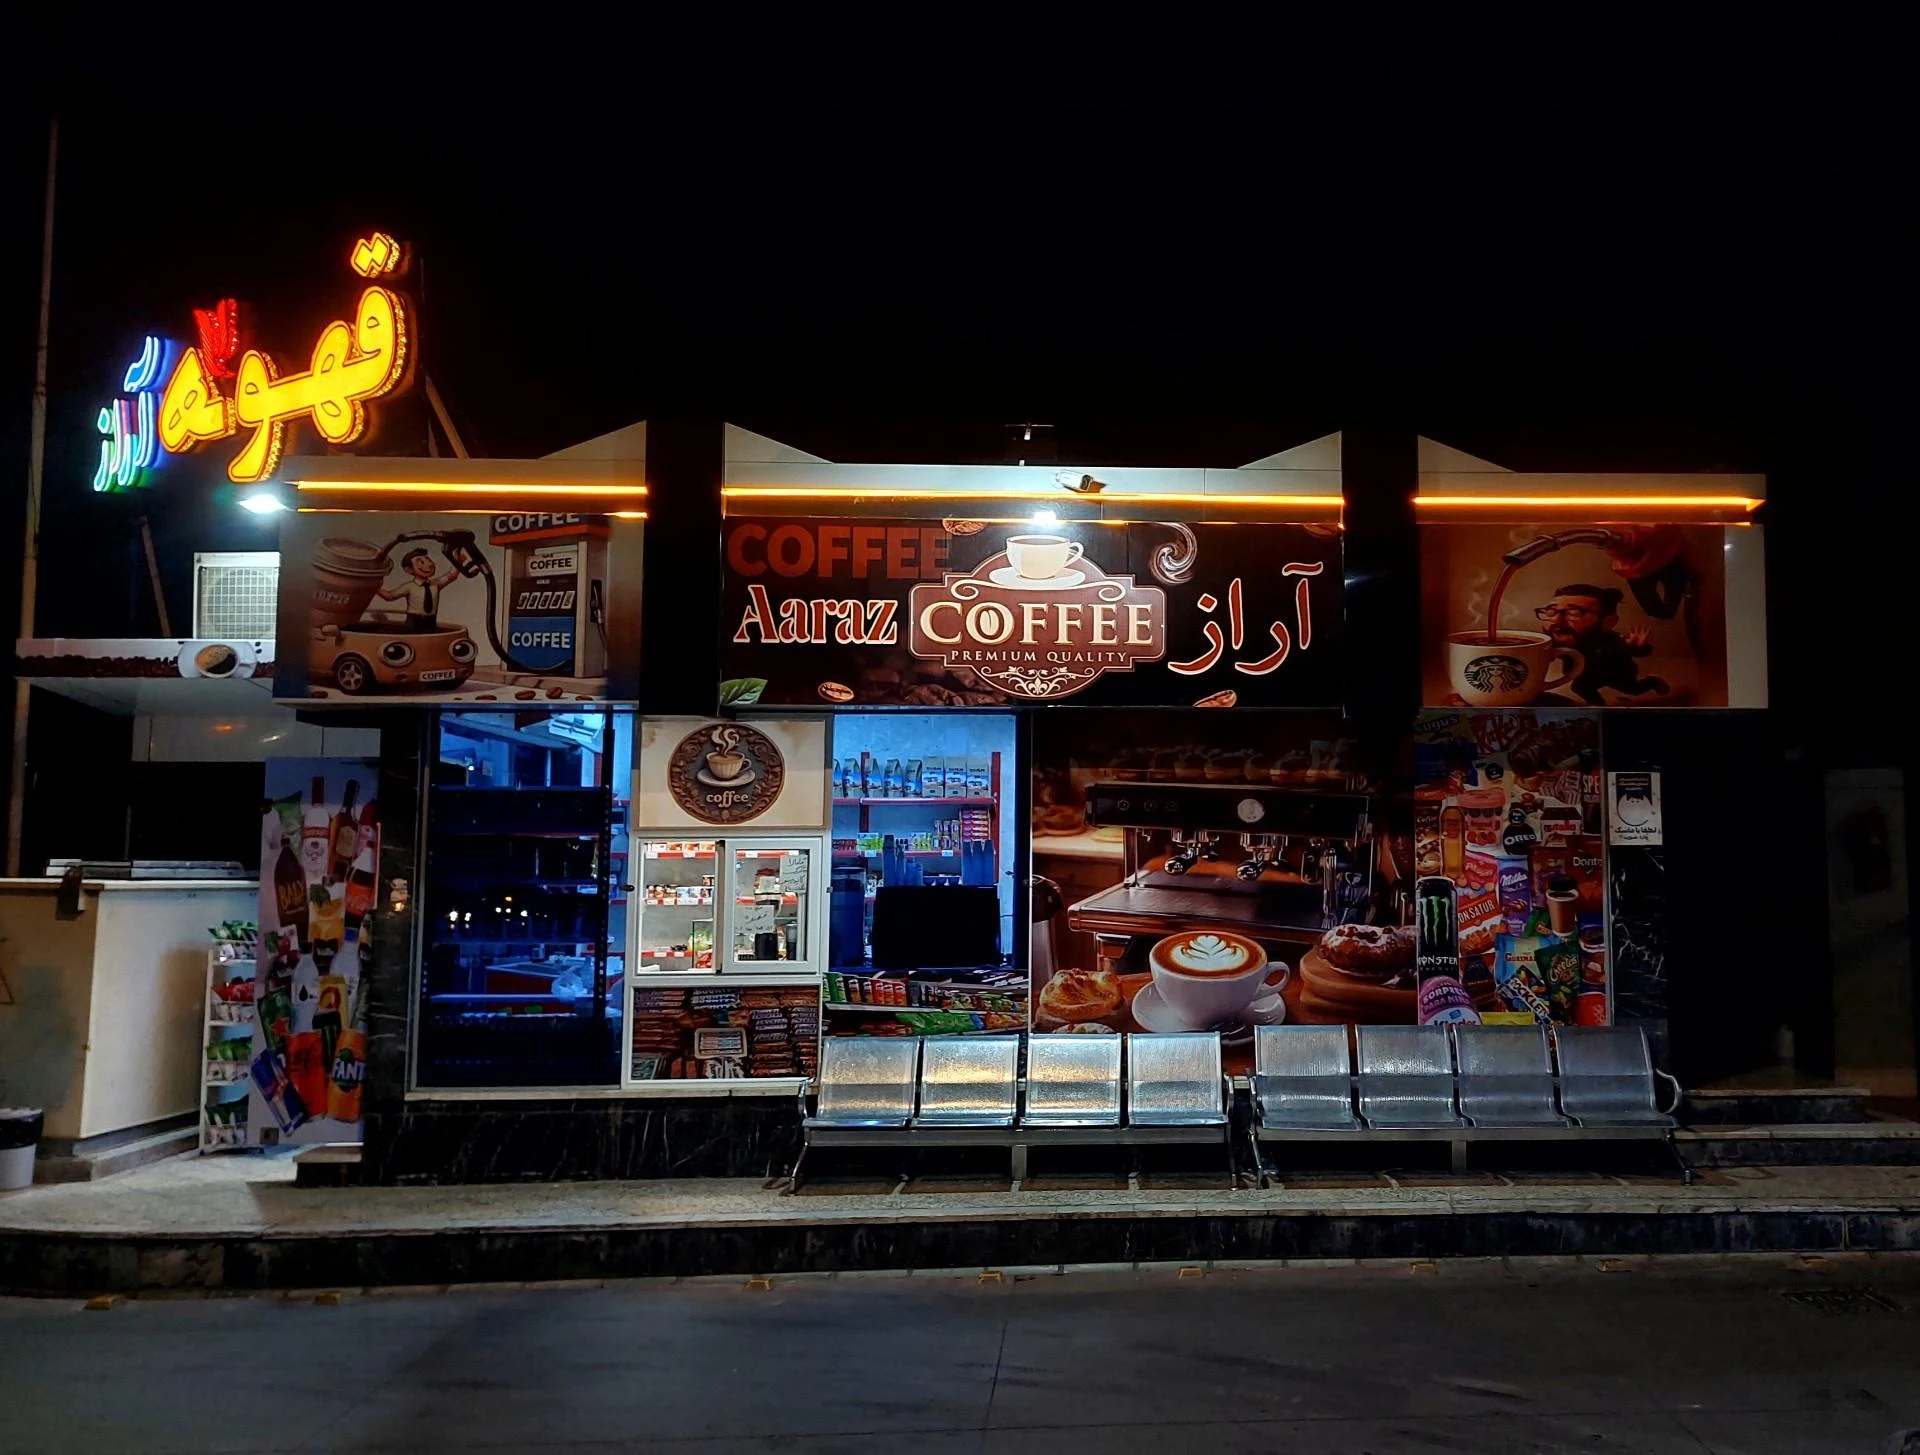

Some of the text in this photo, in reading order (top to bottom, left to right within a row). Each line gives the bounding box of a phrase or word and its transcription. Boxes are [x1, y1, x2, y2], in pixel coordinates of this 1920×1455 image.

[158, 232, 402, 483] قهوه
[727, 524, 952, 579] COFFEE
[530, 557, 573, 570] COFFEE
[733, 584, 898, 645] Aaraz
[919, 601, 1154, 646] COFFEE
[1167, 561, 1324, 676] آراز
[510, 631, 571, 649] COFFEE
[951, 650, 1128, 664] PREMIUM QUALITY
[421, 671, 454, 681] COFFEE
[705, 790, 749, 808] coffee
[1500, 872, 1529, 887] Milka
[331, 1057, 367, 1082] FANT
